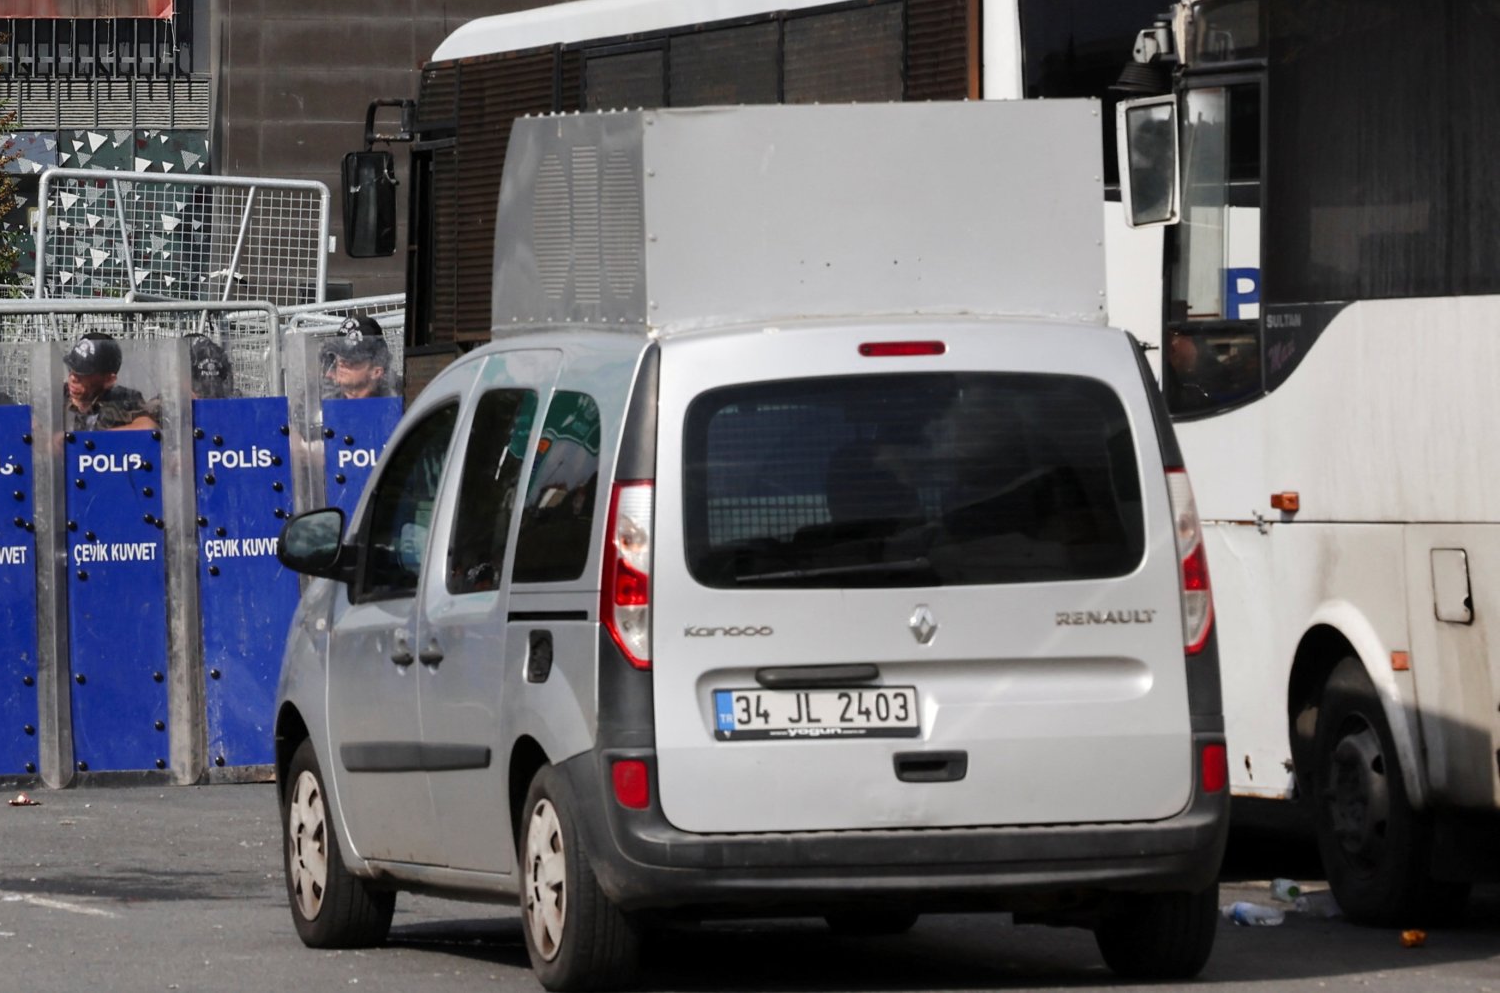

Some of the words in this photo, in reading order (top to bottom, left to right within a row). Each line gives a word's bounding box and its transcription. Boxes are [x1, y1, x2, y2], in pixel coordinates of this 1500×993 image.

[208, 445, 272, 468] POLİS
[339, 444, 386, 468] POL
[111, 542, 157, 561] KUVVET
[1056, 609, 1157, 626] RENAULT
[720, 713, 734, 723] TR
[736, 694, 770, 725] 34
[788, 692, 821, 723] JL
[837, 691, 910, 722] 2403
